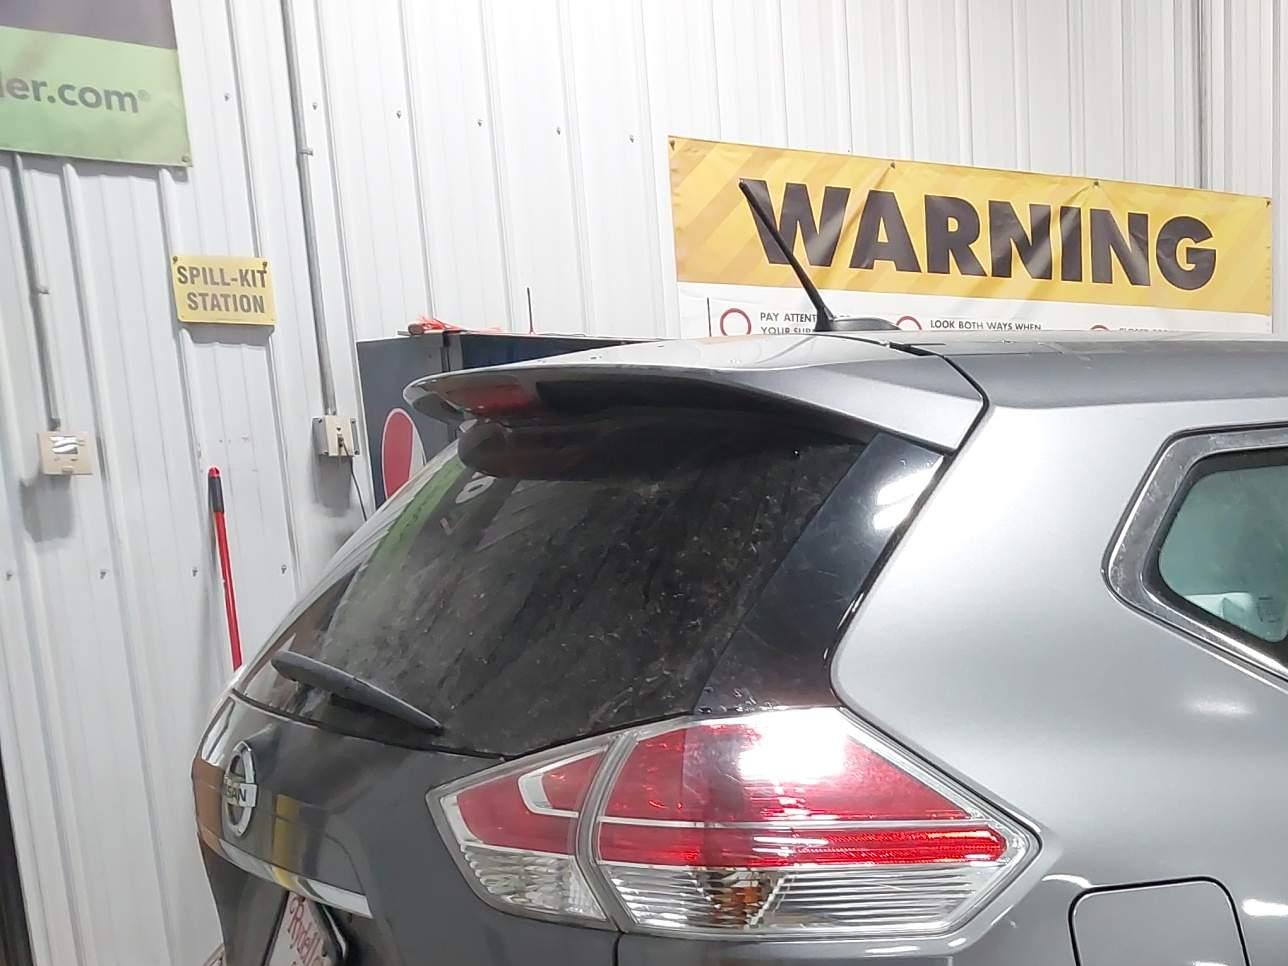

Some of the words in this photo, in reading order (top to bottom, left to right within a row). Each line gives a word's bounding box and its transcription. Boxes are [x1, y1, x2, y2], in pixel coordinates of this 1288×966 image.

[741, 180, 1217, 290] WARNING
[177, 265, 268, 289] SPILL-KIT
[186, 291, 265, 314] STATION
[760, 312, 780, 322] PAY
[783, 313, 817, 323] ATTENT
[930, 319, 956, 329] LOOK
[958, 320, 984, 330] BOTH
[986, 321, 1013, 331] WAYS
[1015, 323, 1042, 331] WHEN
[760, 326, 790, 335] YOUR
